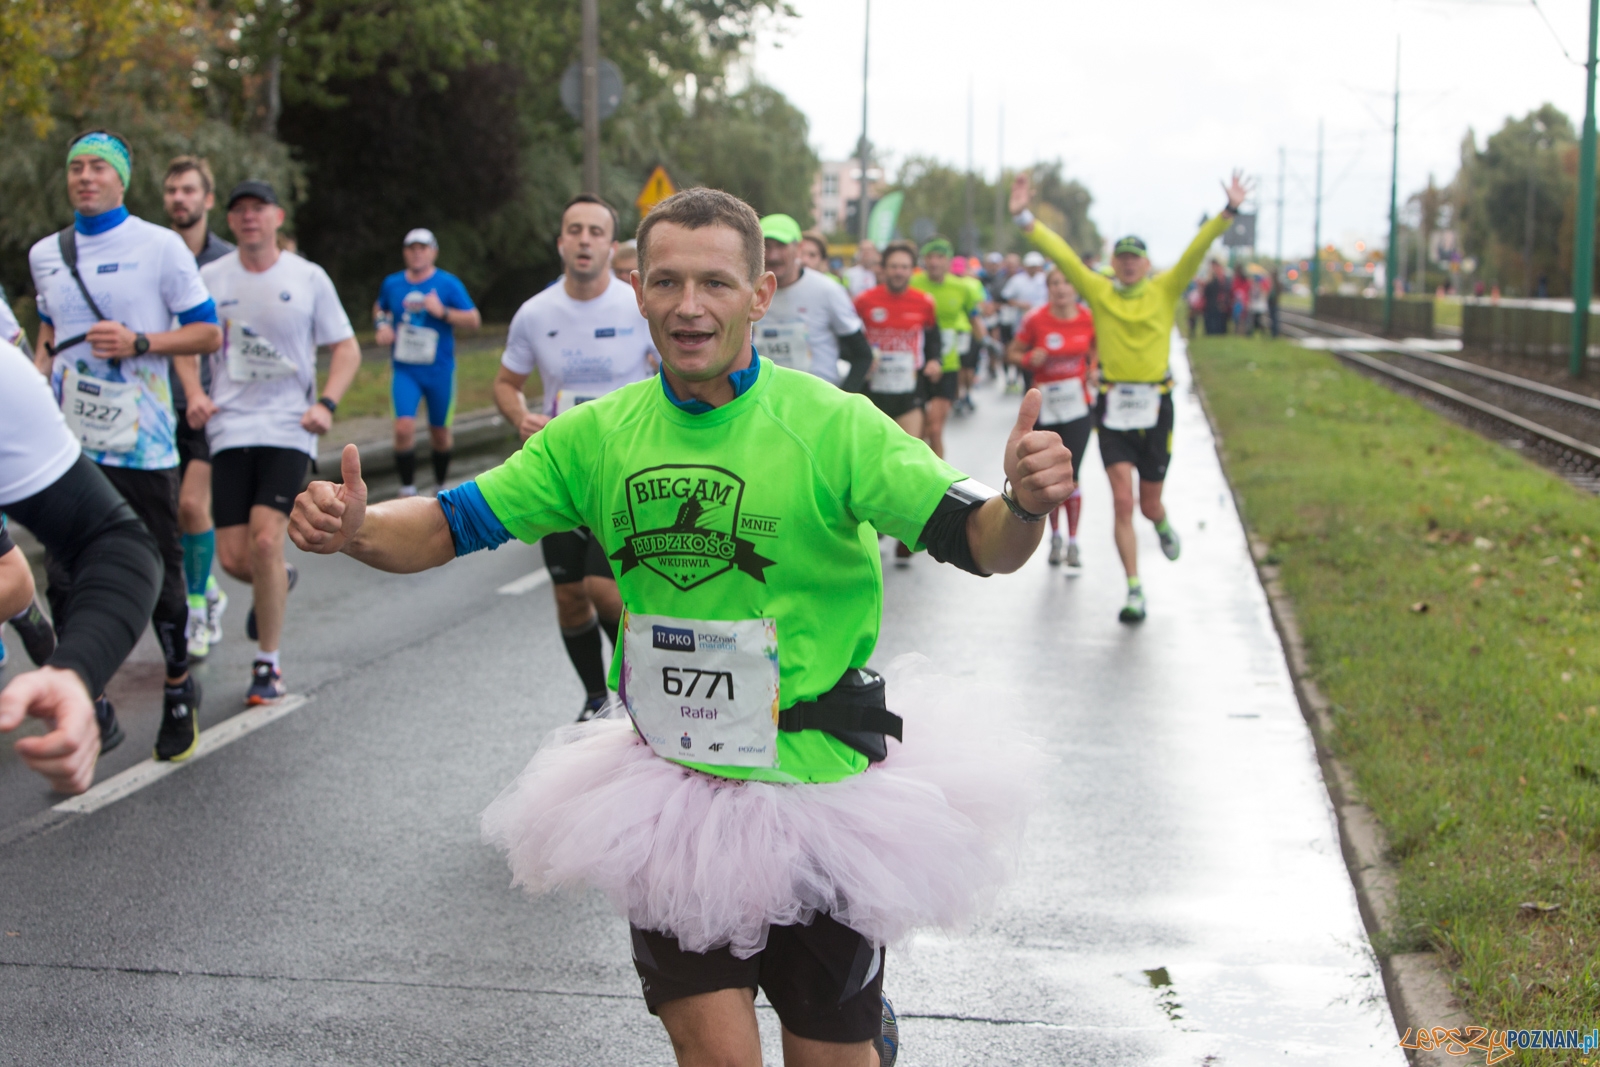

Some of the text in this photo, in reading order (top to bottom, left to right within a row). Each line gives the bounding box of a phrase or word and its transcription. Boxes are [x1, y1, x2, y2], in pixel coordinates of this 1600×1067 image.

[74, 399, 122, 421] 3227
[633, 477, 734, 506] BIEGAM
[612, 515, 629, 528] BO
[741, 517, 777, 533] MNIE
[631, 532, 736, 559] LUDZKOŚĆ
[657, 557, 711, 568] WKURWIA
[662, 666, 734, 701] 6771
[680, 706, 719, 720] Rafał
